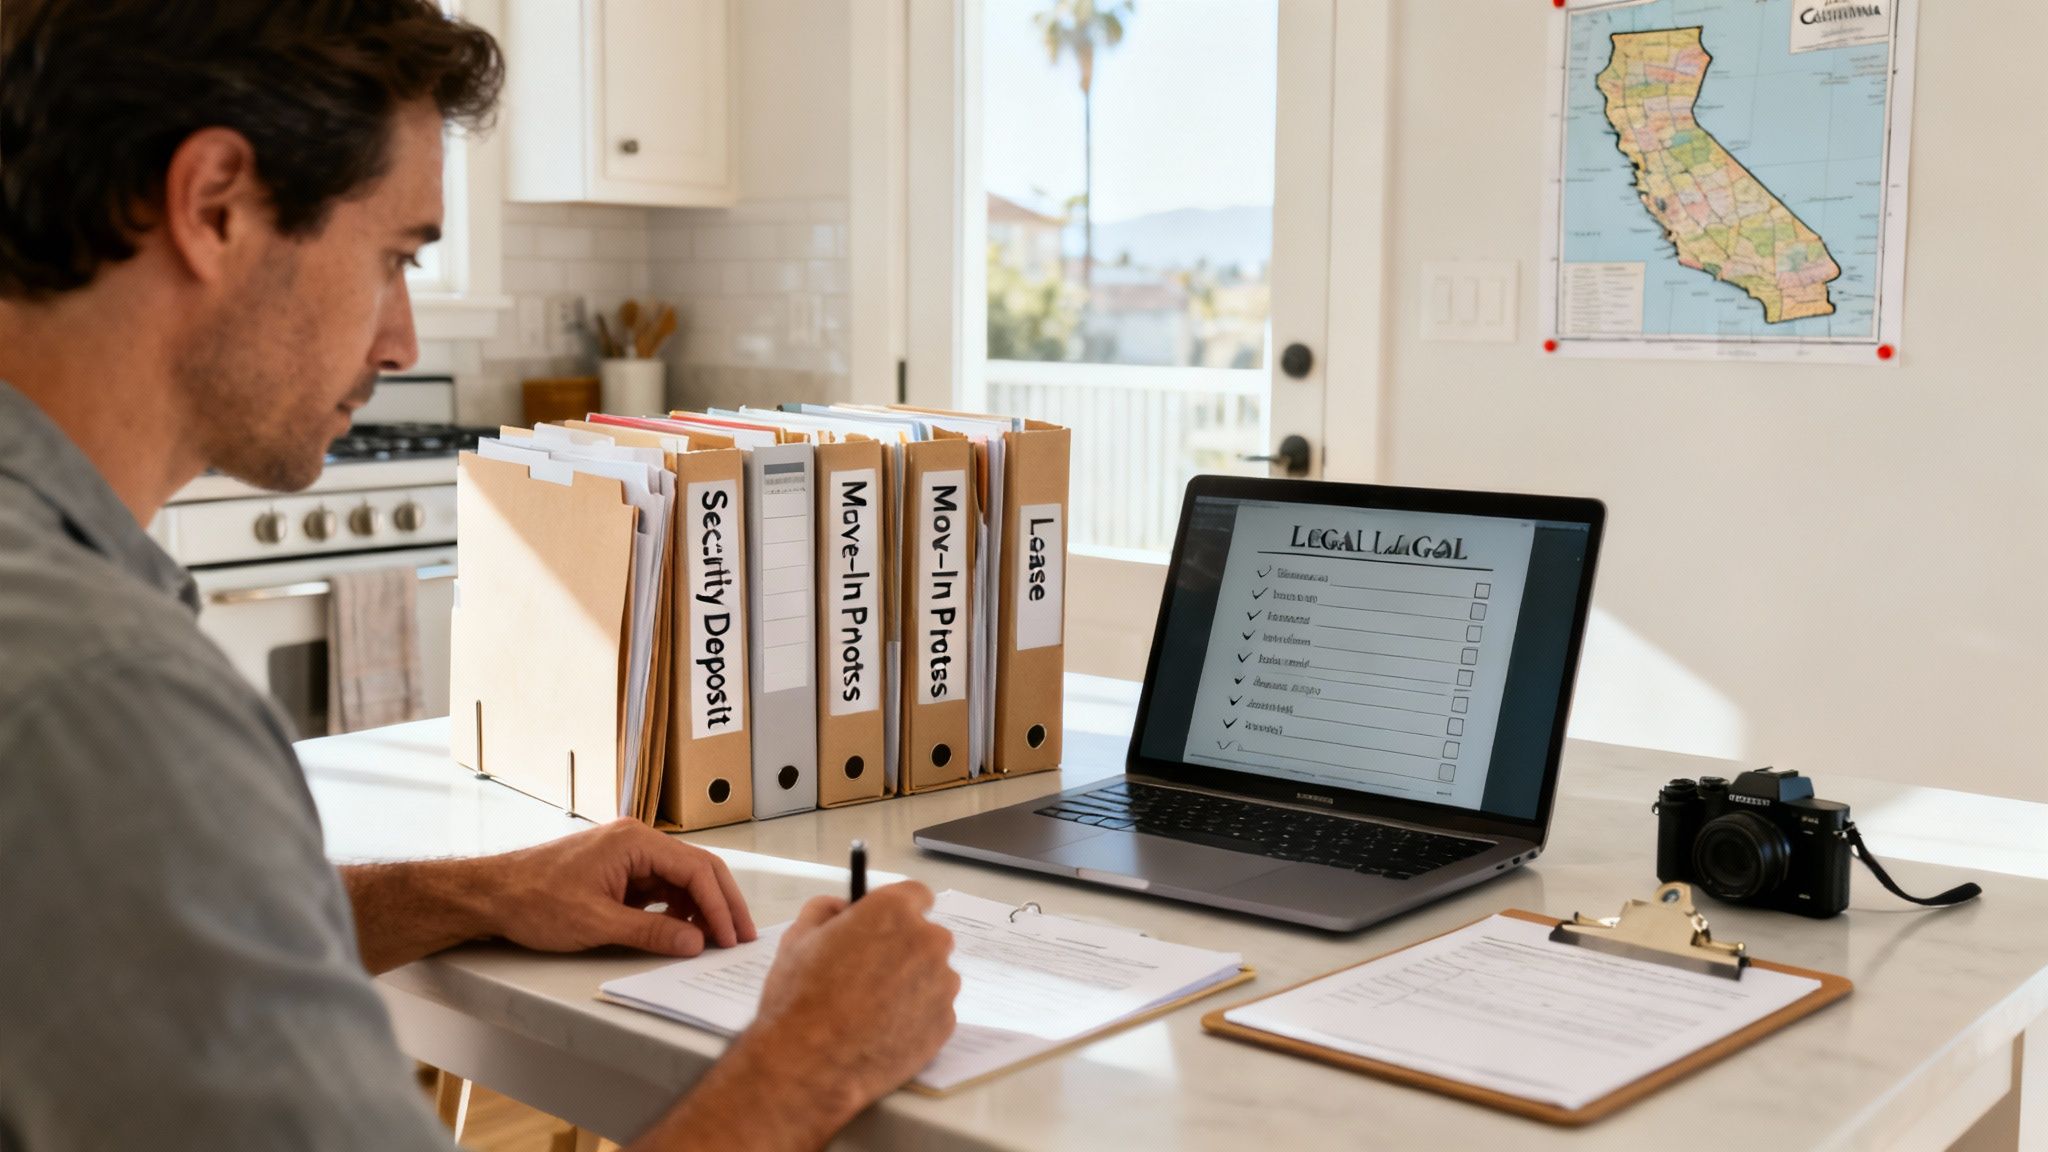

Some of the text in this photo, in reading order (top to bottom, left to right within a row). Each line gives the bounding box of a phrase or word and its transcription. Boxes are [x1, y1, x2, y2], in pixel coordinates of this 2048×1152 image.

[841, 481, 870, 600] Move-In
[932, 485, 958, 599] Mov-In
[696, 612, 732, 730] Deposit
